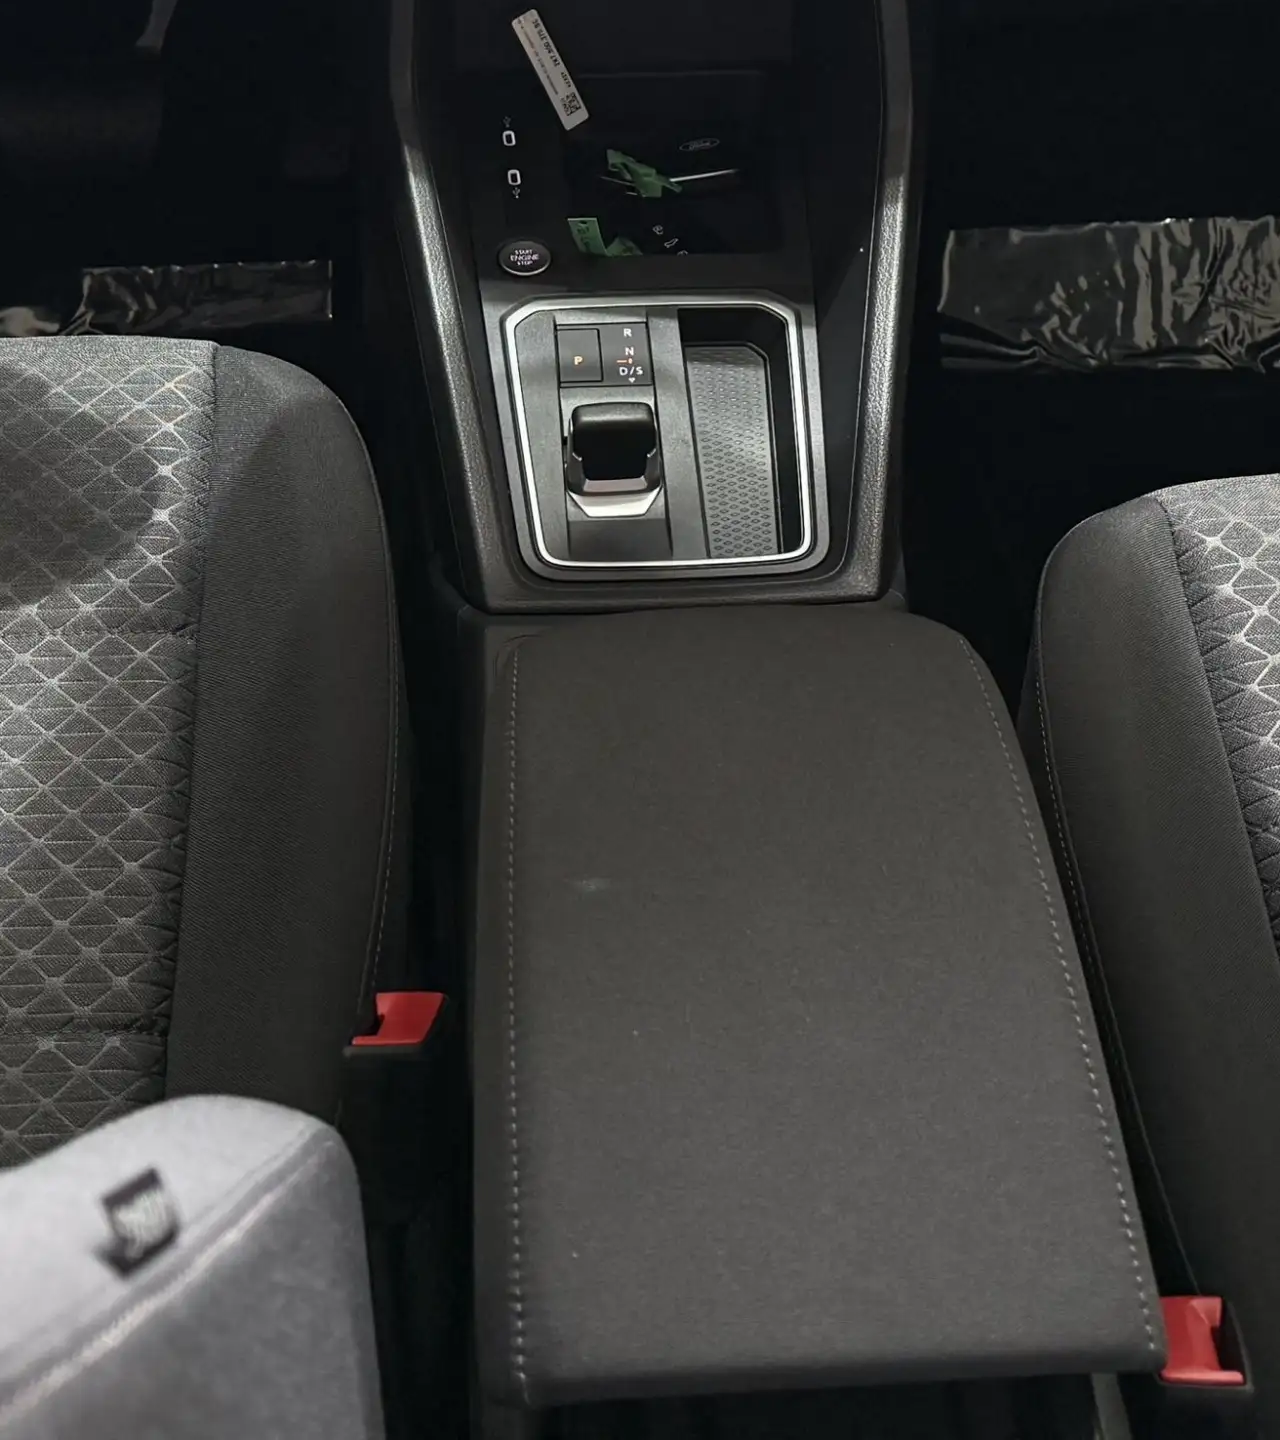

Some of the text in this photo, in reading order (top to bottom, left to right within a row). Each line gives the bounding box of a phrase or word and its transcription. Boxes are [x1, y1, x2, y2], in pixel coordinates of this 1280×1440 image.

[623, 328, 632, 337] R
[625, 346, 634, 356] N
[574, 356, 583, 365] P
[619, 366, 644, 376] D/S
